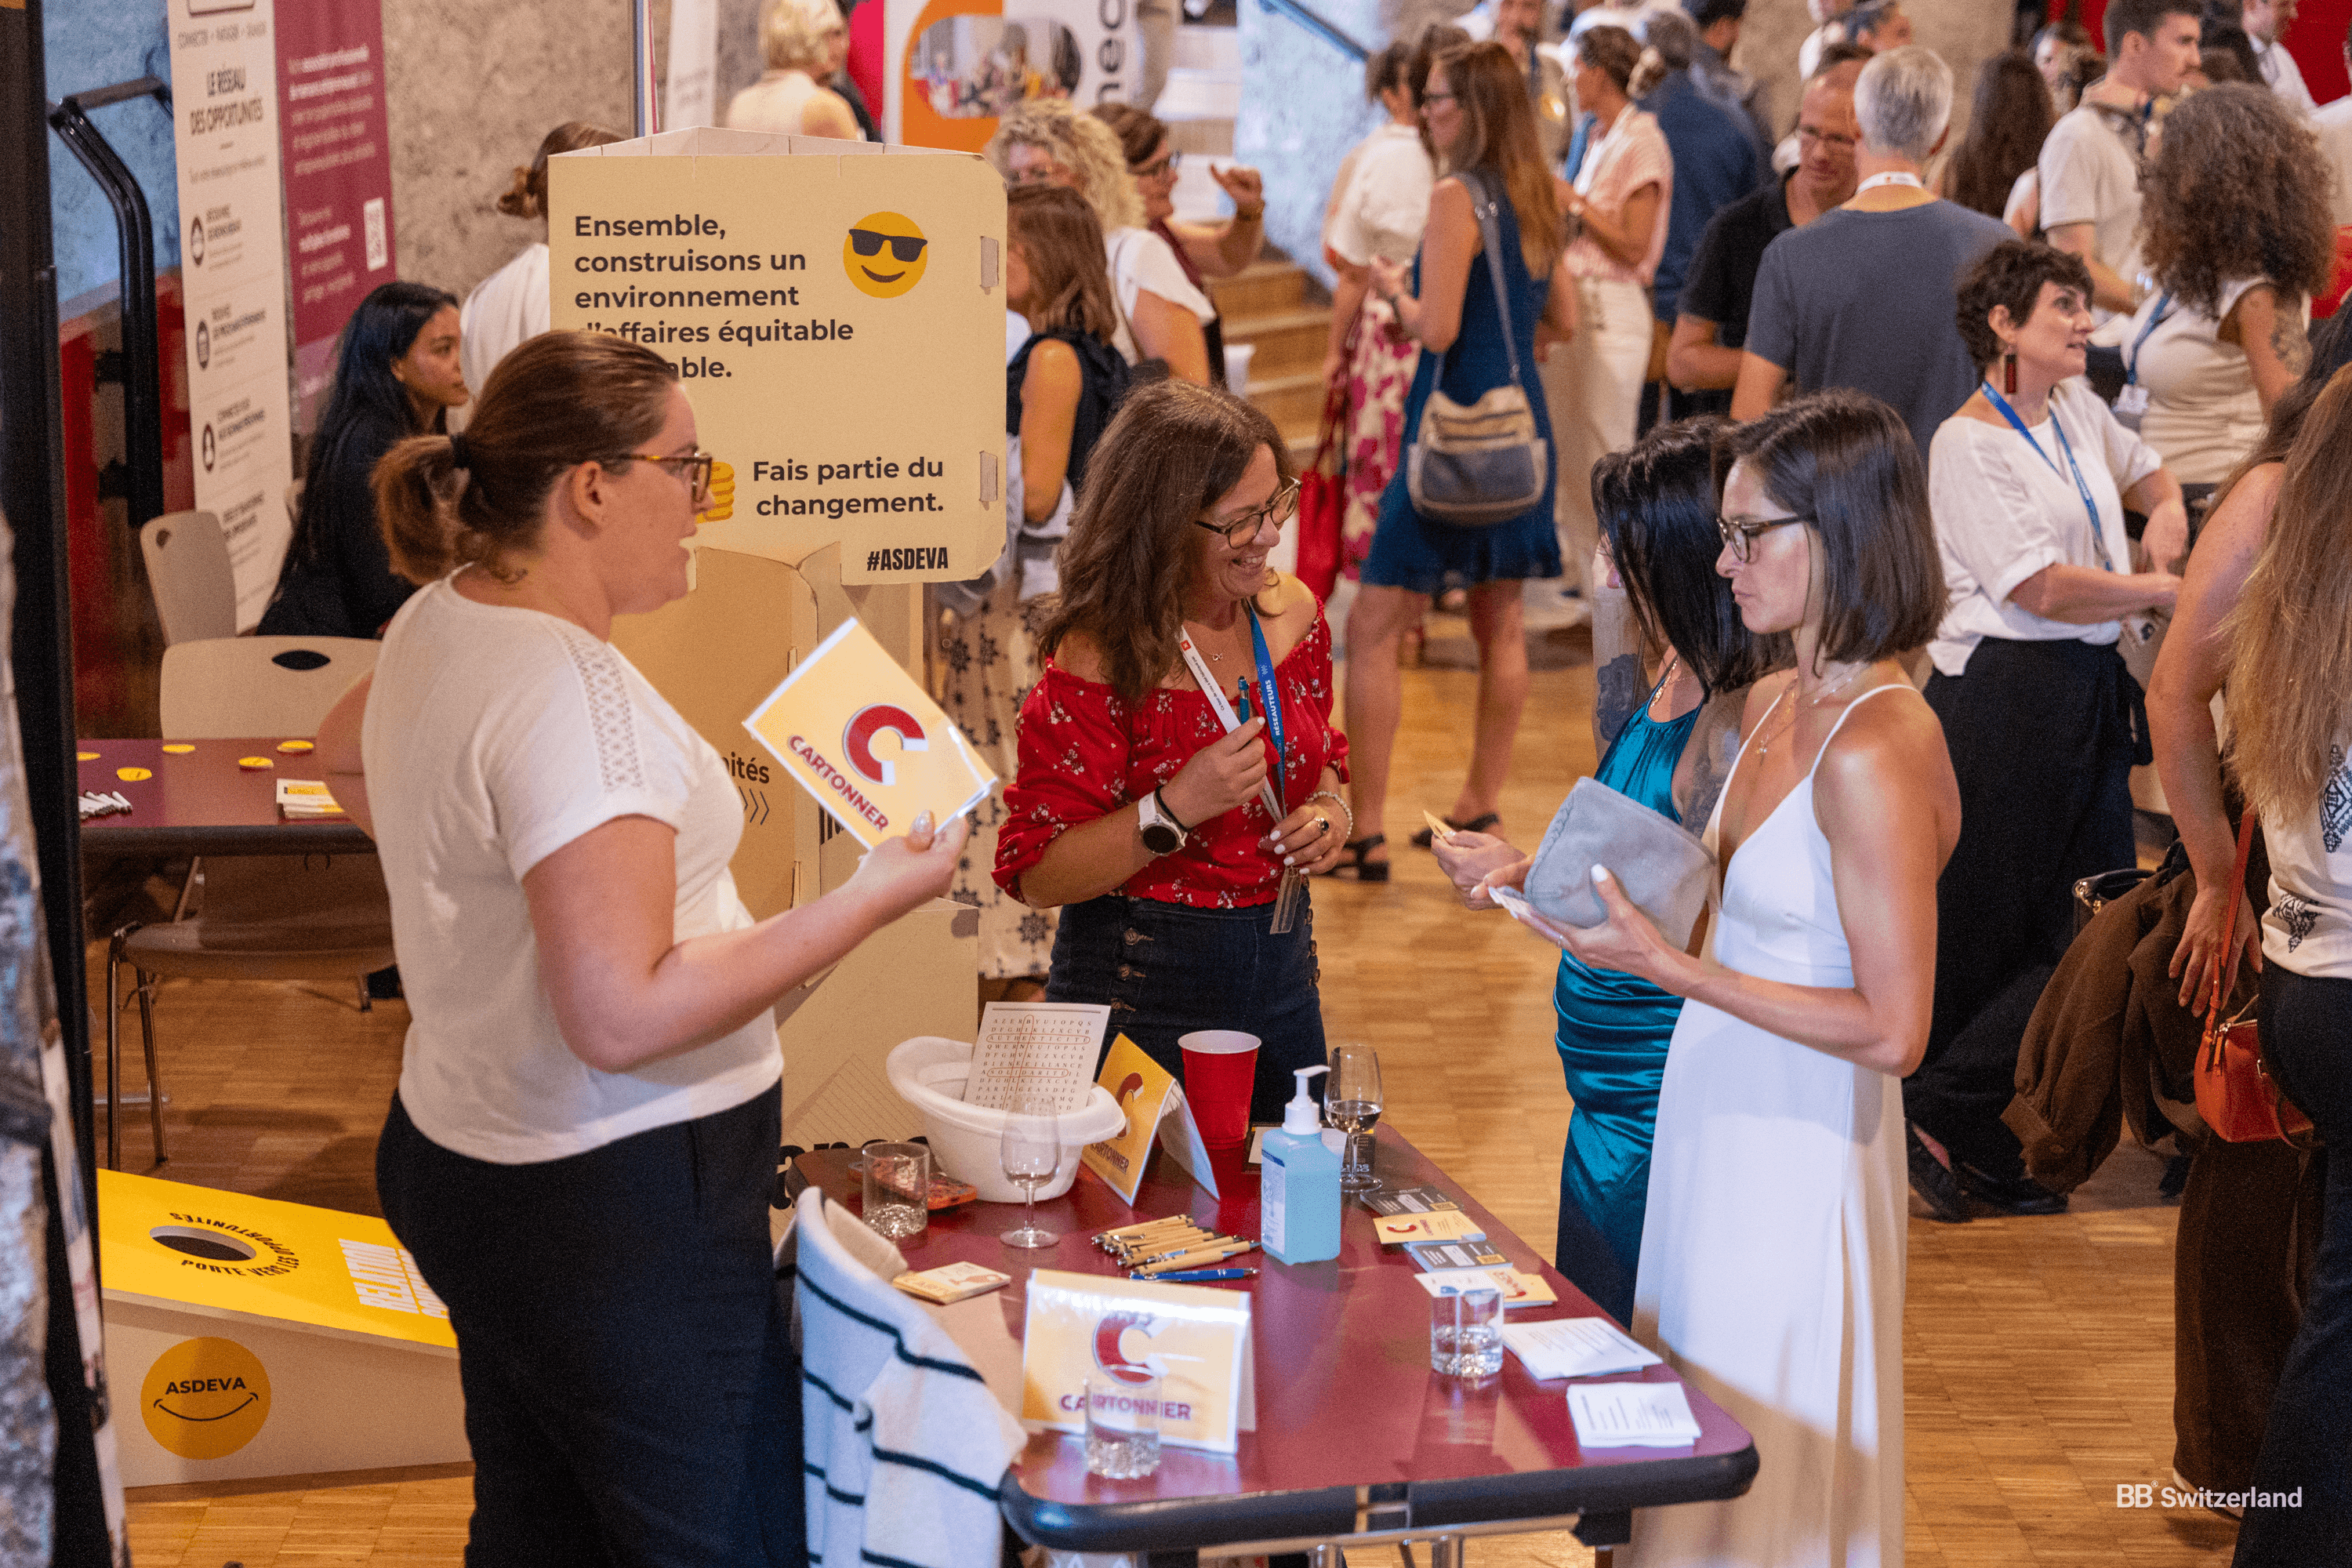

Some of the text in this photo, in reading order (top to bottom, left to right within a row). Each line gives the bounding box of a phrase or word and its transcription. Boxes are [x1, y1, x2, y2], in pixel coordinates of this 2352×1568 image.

[206, 71, 216, 97] LE
[190, 108, 205, 136] DES
[575, 214, 726, 239] Ensemble,
[575, 249, 806, 273] construisons un
[575, 285, 800, 308] environnement
[718, 318, 854, 347] équitable
[753, 456, 943, 485] Fais partie du
[756, 492, 944, 519] changement.
[867, 546, 949, 571] #ASDEVA
[1265, 679, 1280, 736] RÉSEAUTEURS
[787, 735, 889, 833] CARTONNER
[181, 1259, 246, 1276] PORTE
[246, 1265, 291, 1276] VERS
[275, 1255, 299, 1269] LES
[165, 1377, 247, 1395] ASDEVA
